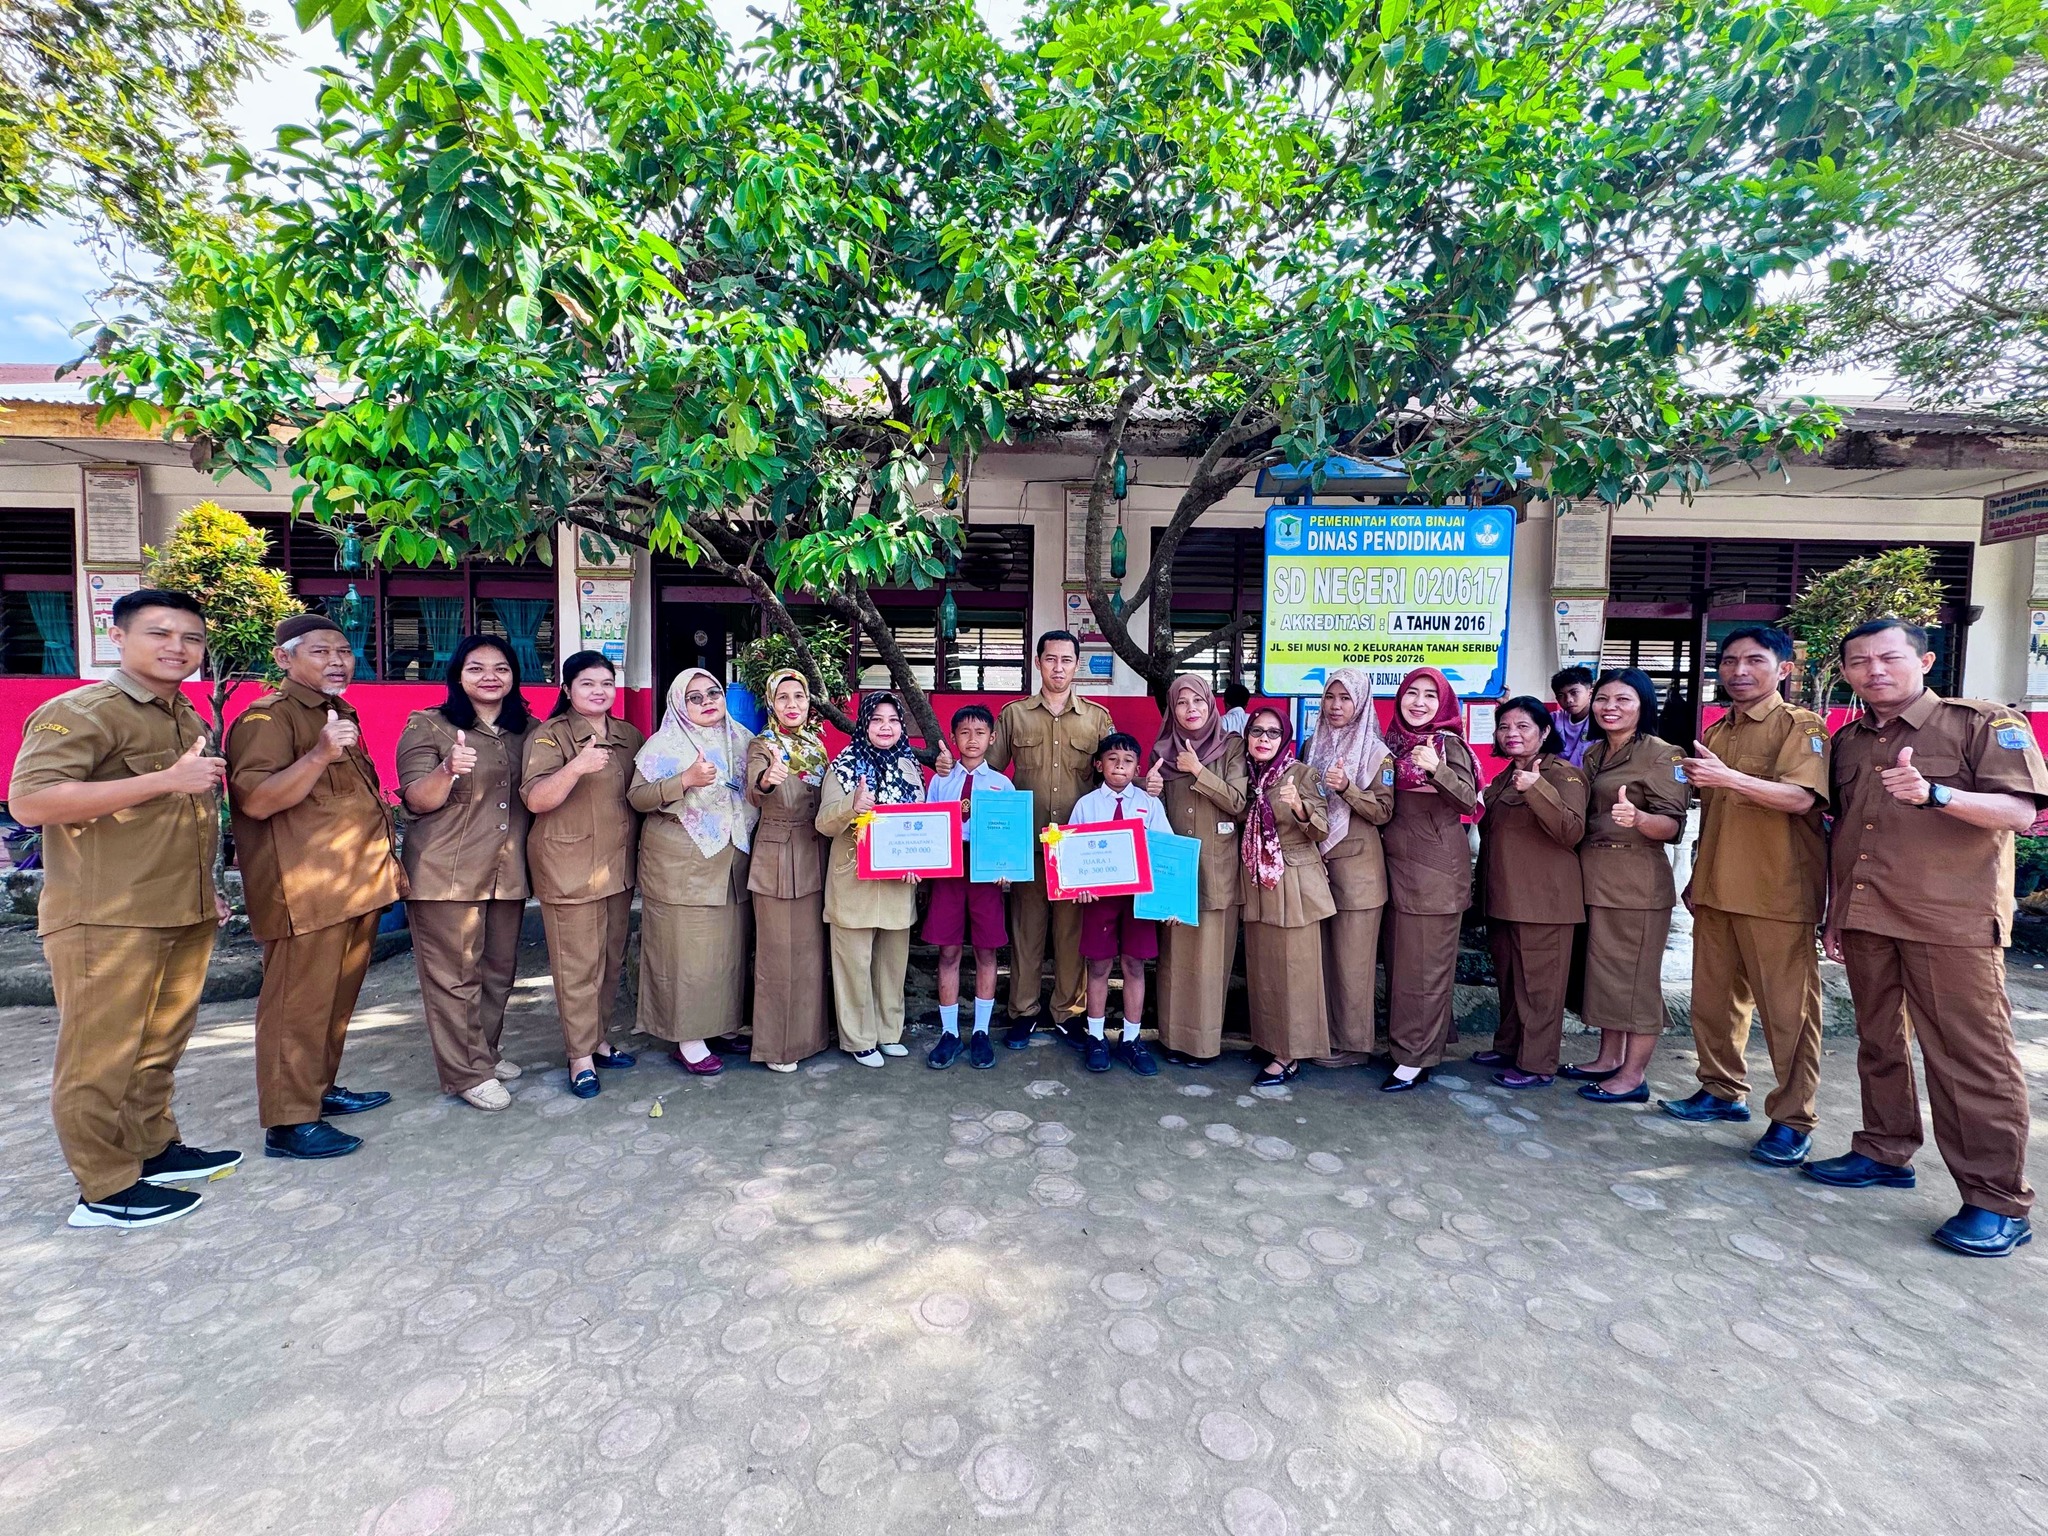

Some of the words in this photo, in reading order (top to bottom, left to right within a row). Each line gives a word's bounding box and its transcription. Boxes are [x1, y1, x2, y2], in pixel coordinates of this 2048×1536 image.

[1310, 516, 1386, 526] PEMERINTAH
[1390, 516, 1422, 526] KOTA
[1426, 516, 1465, 526] BINJAI
[1307, 531, 1357, 550] DINAS
[1363, 531, 1465, 551] PENDIDIKAN
[1273, 567, 1306, 604] SD
[1314, 567, 1406, 604] NEGERI
[1414, 567, 1502, 604] 020617
[1280, 614, 1375, 631] AKREDITASI
[1393, 616, 1403, 631] A
[1407, 616, 1450, 631] TAHUN
[1454, 616, 1485, 631] 2016
[1270, 643, 1284, 652] JL.
[1288, 643, 1303, 652] SEI
[1306, 643, 1330, 652] MUSI
[1334, 643, 1350, 652] NO.
[1353, 643, 1359, 652] 2
[1363, 643, 1422, 652] KELURAHAN
[1426, 643, 1459, 652] TANAH
[1462, 643, 1499, 652] SERIBU
[1343, 654, 1370, 663] KODE
[1373, 654, 1392, 663] POS
[1395, 654, 1425, 663] 20726
[1376, 672, 1401, 686] BINJAI
